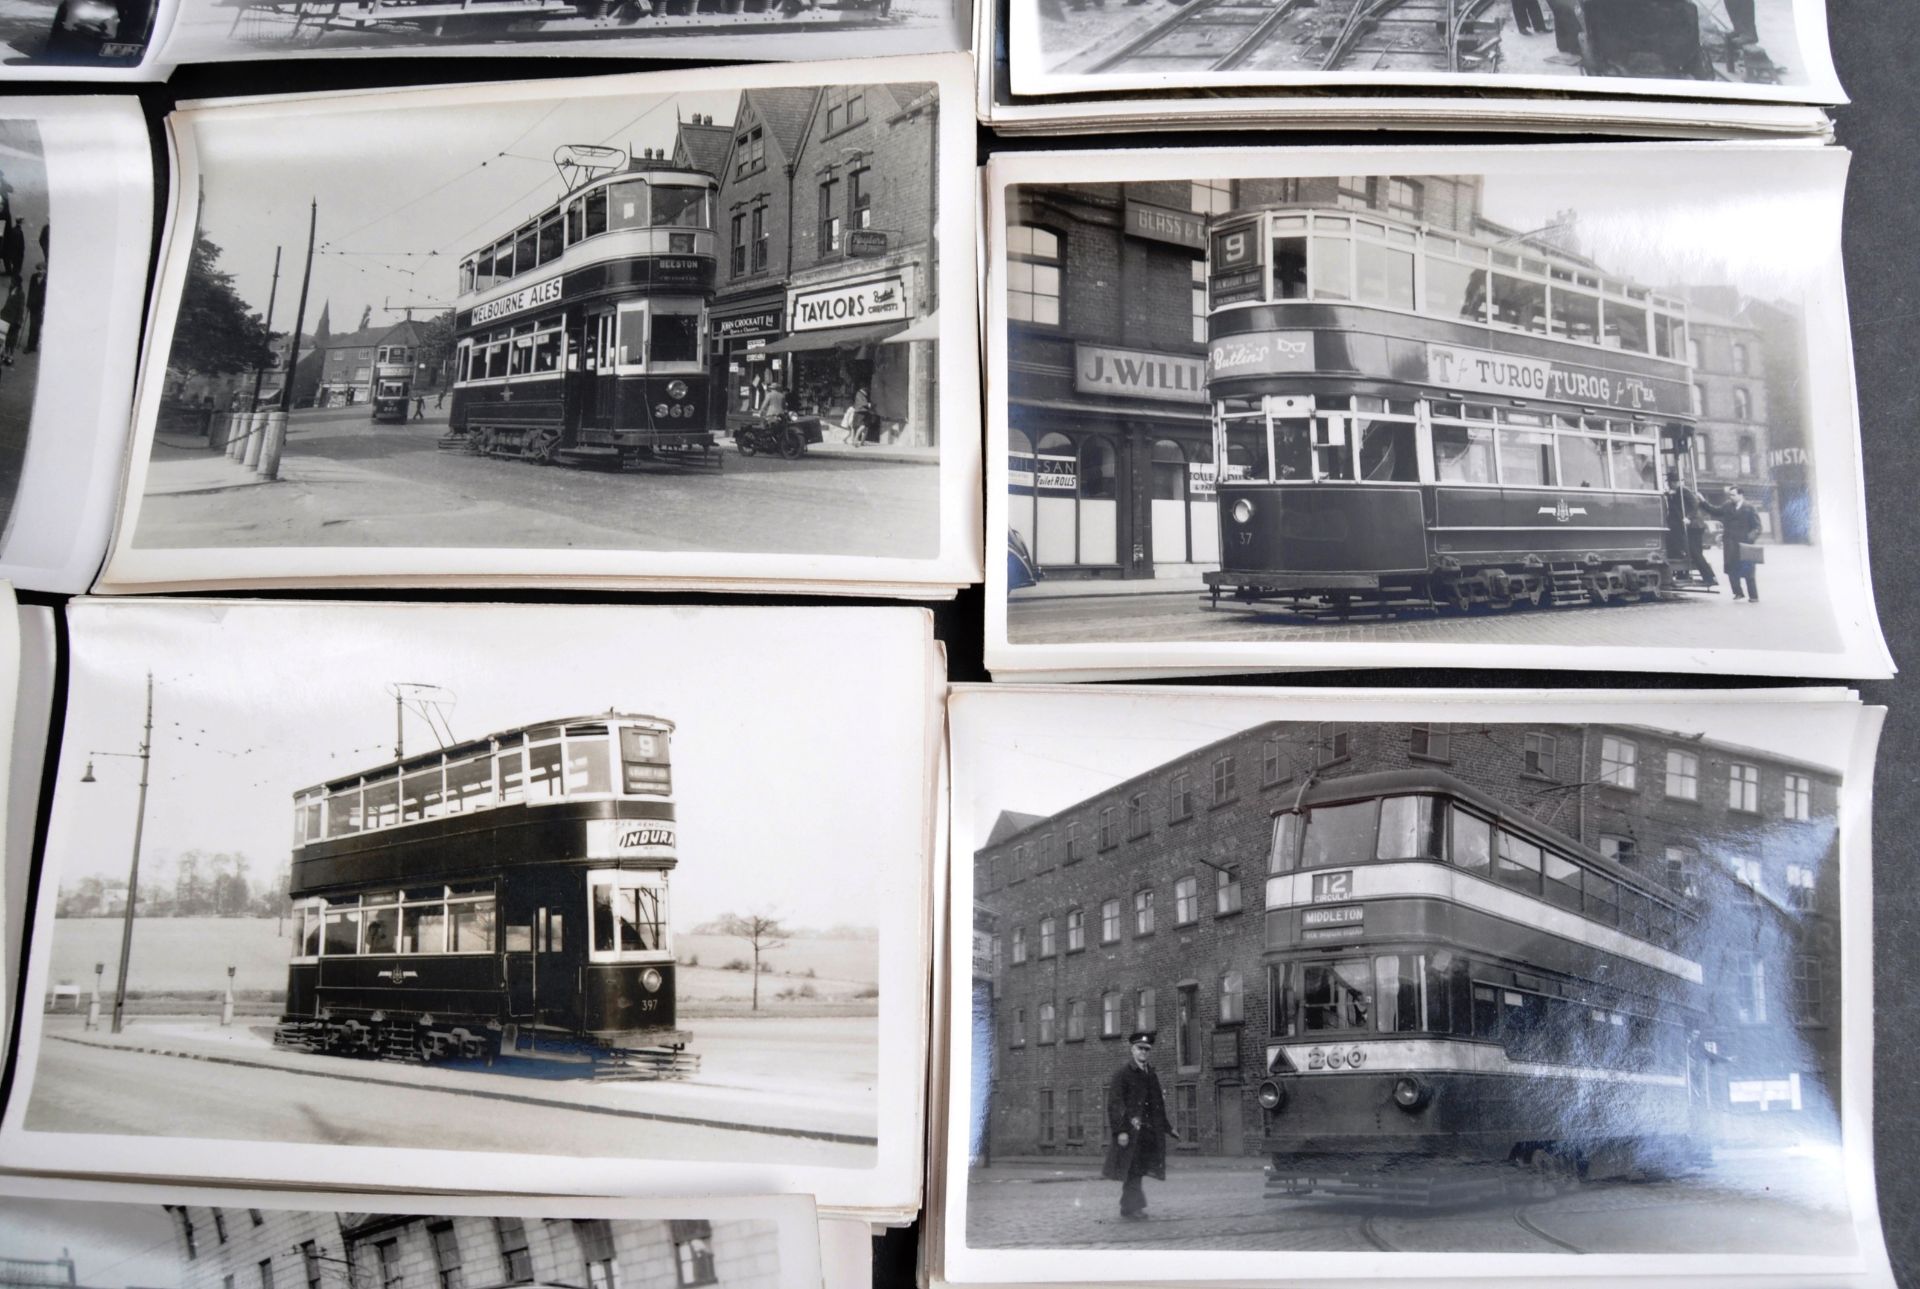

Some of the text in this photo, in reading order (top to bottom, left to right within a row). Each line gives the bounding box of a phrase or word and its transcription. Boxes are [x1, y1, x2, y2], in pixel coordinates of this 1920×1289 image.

[1226, 232, 1245, 262] 9
[659, 259, 698, 269] BEESTON
[473, 279, 561, 323] MELBOURNE ALES
[801, 294, 864, 323] TAYLORS
[1085, 356, 1198, 391] J.WILLI
[1432, 350, 1454, 383] T
[1475, 359, 1544, 390] TUROG
[1549, 369, 1610, 401] TUROG
[1769, 447, 1810, 467] INSTA
[1054, 476, 1076, 487] ROLLS
[639, 735, 653, 757] 9
[1322, 874, 1346, 894] 12
[1306, 908, 1363, 923] MIDDLETON
[642, 1000, 658, 1011] 397
